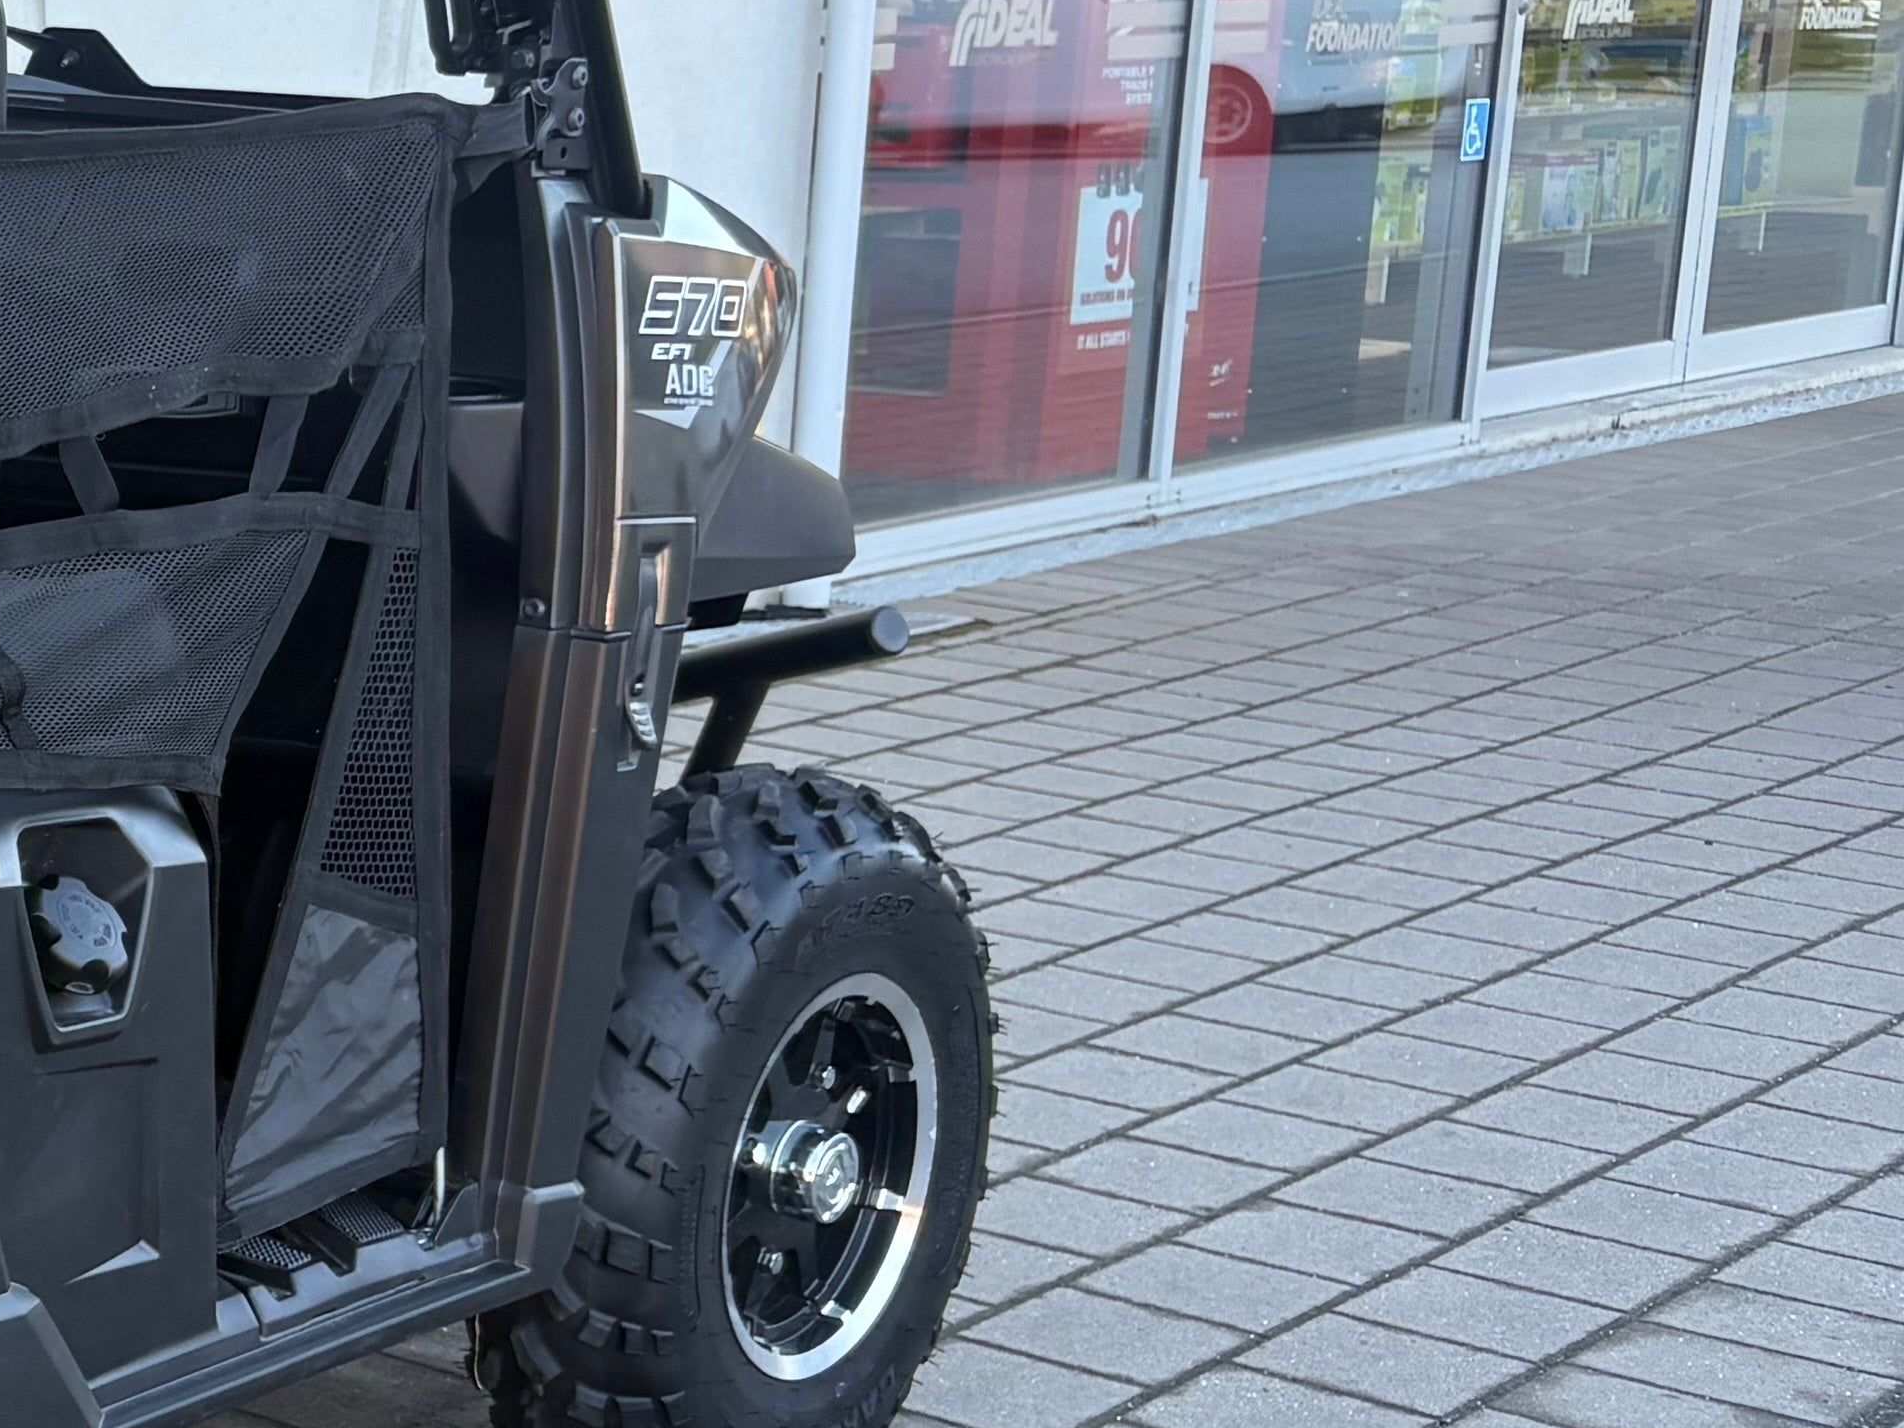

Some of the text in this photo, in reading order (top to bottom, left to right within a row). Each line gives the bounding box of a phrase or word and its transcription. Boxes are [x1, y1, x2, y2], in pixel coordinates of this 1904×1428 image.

[1305, 21, 1403, 52] FOUNDATION
[638, 275, 748, 338] 570
[651, 342, 693, 361] EFI
[665, 363, 715, 397] ADC
